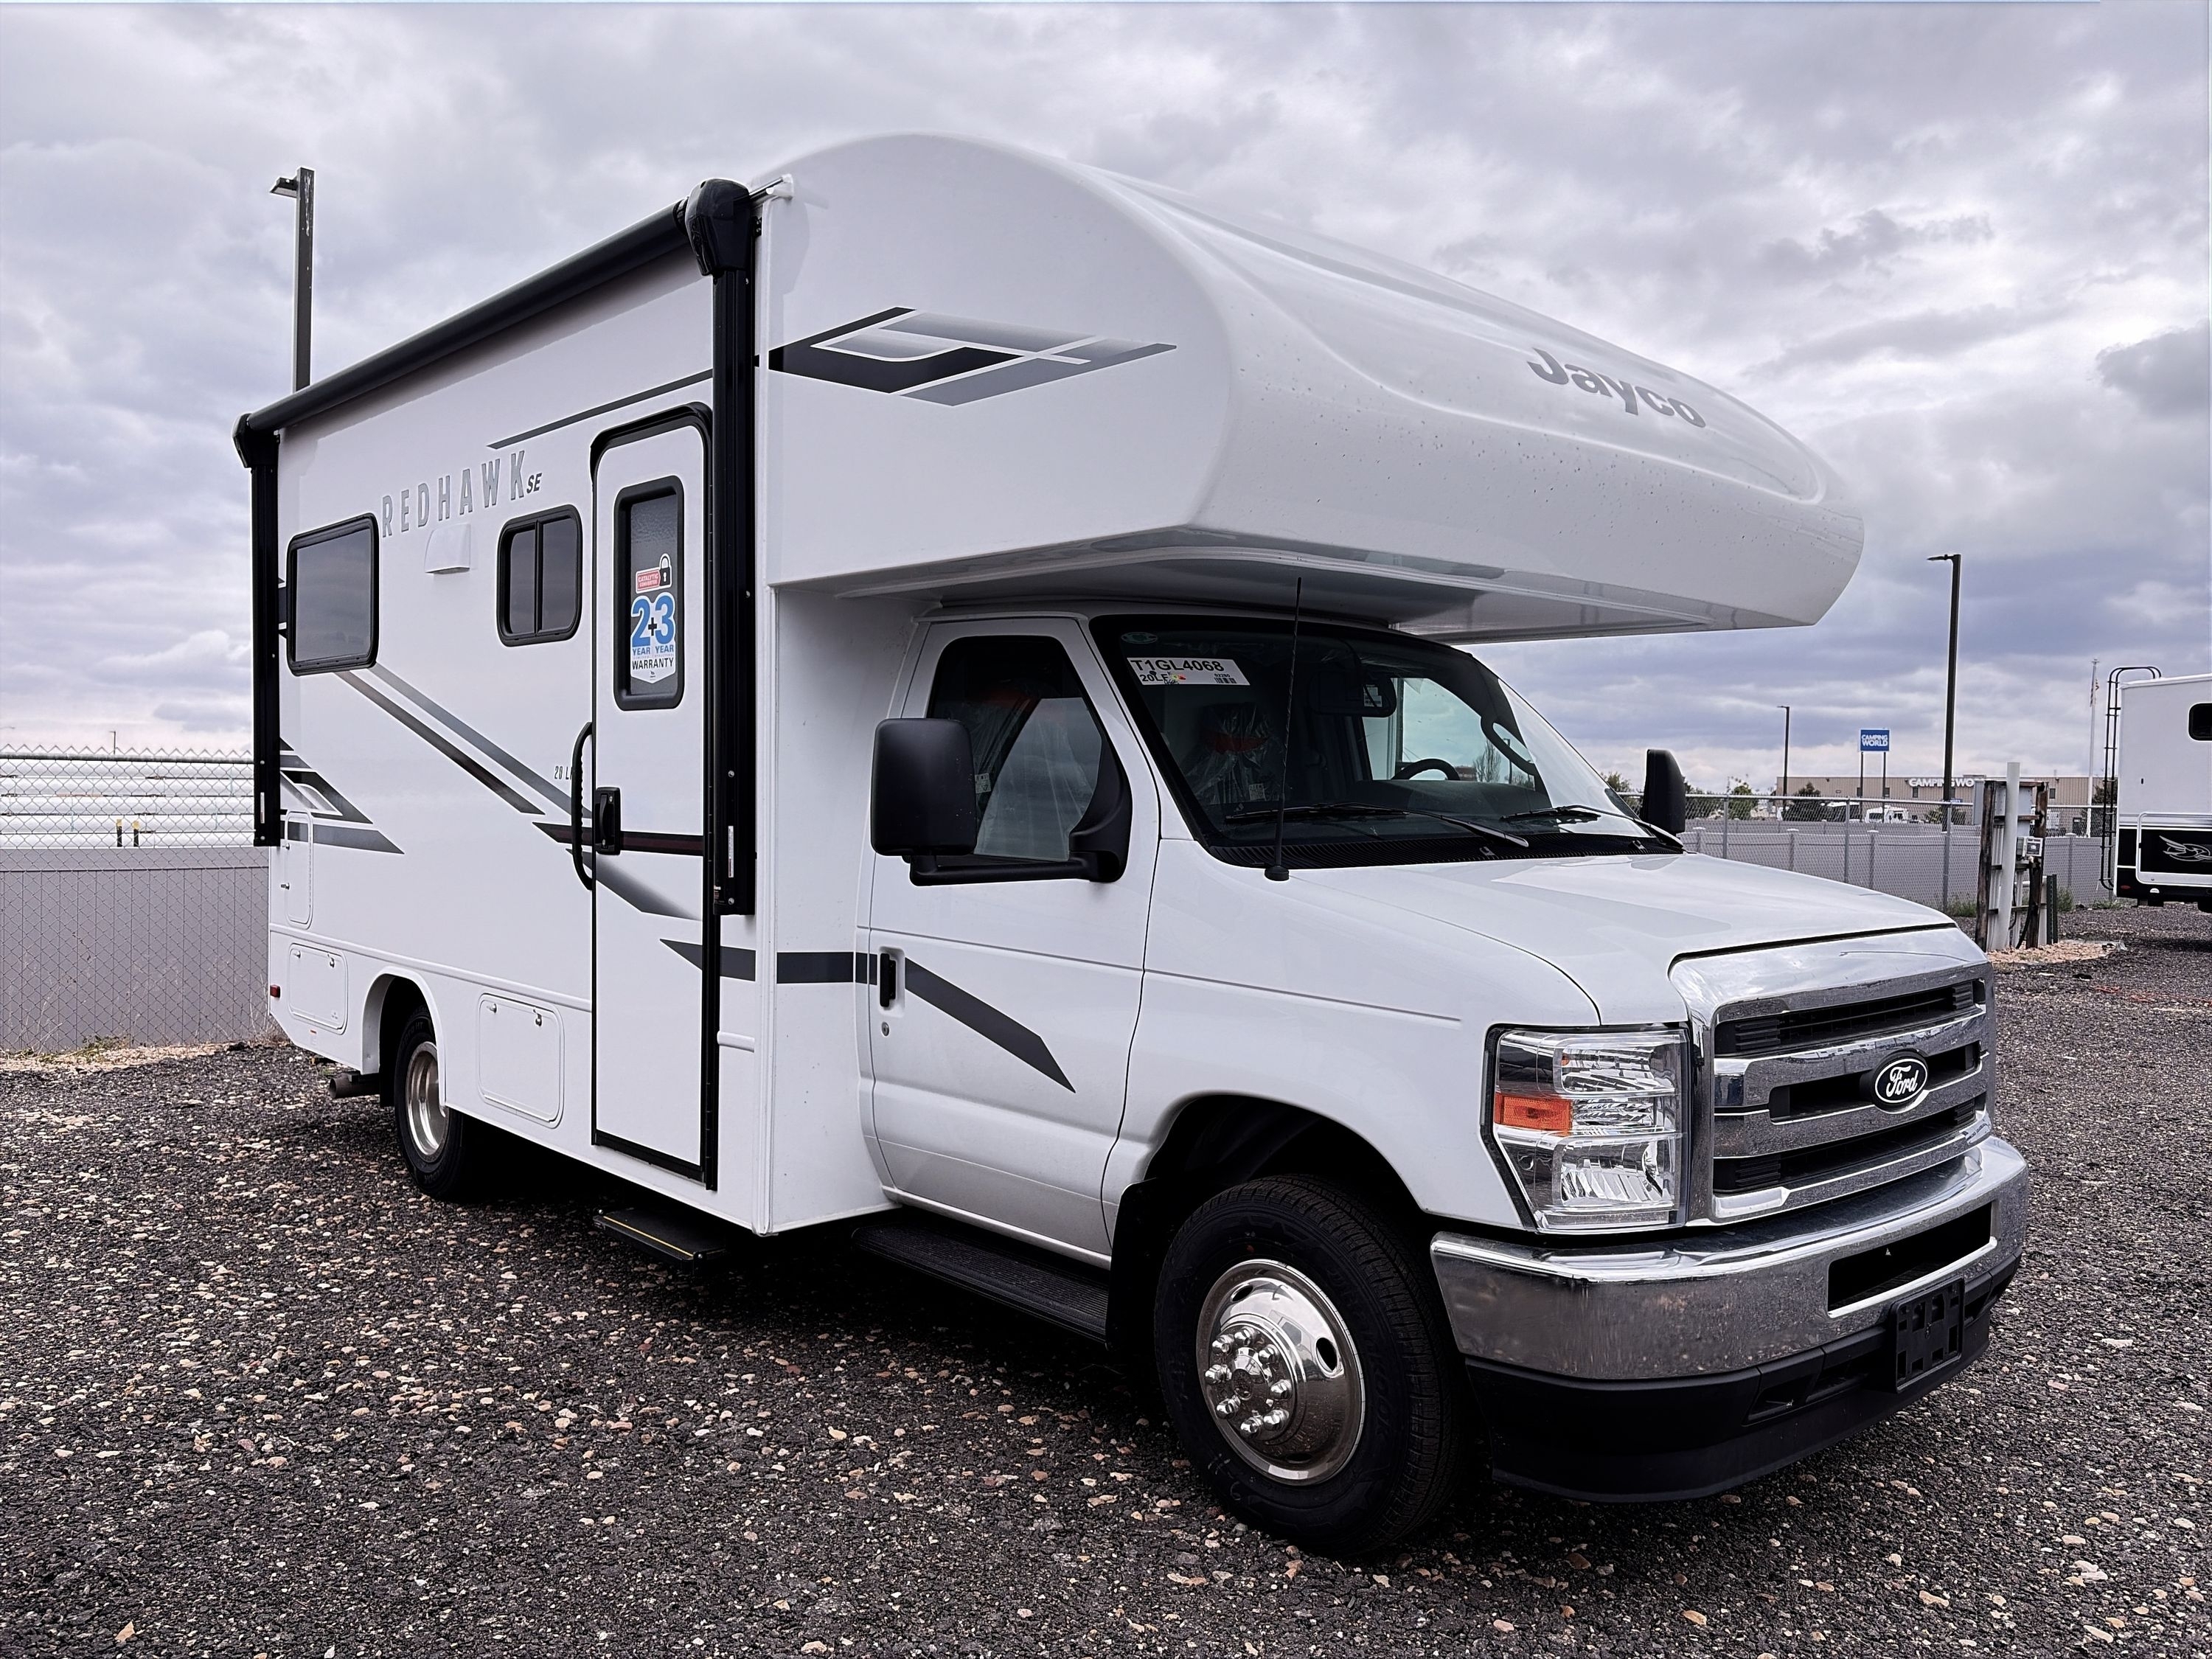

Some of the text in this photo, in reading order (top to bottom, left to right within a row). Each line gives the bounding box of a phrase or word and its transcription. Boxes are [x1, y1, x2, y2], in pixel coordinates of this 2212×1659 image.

[1527, 347, 1705, 428] Jayco
[382, 451, 543, 538] REDHAWK SE
[632, 647, 650, 656] YEAR
[655, 644, 674, 654] YEAR
[632, 658, 674, 670] WARRANTY
[1130, 660, 1225, 672] T1GL4068
[554, 765, 563, 779] 20
[1886, 1065, 1919, 1097] Ford
